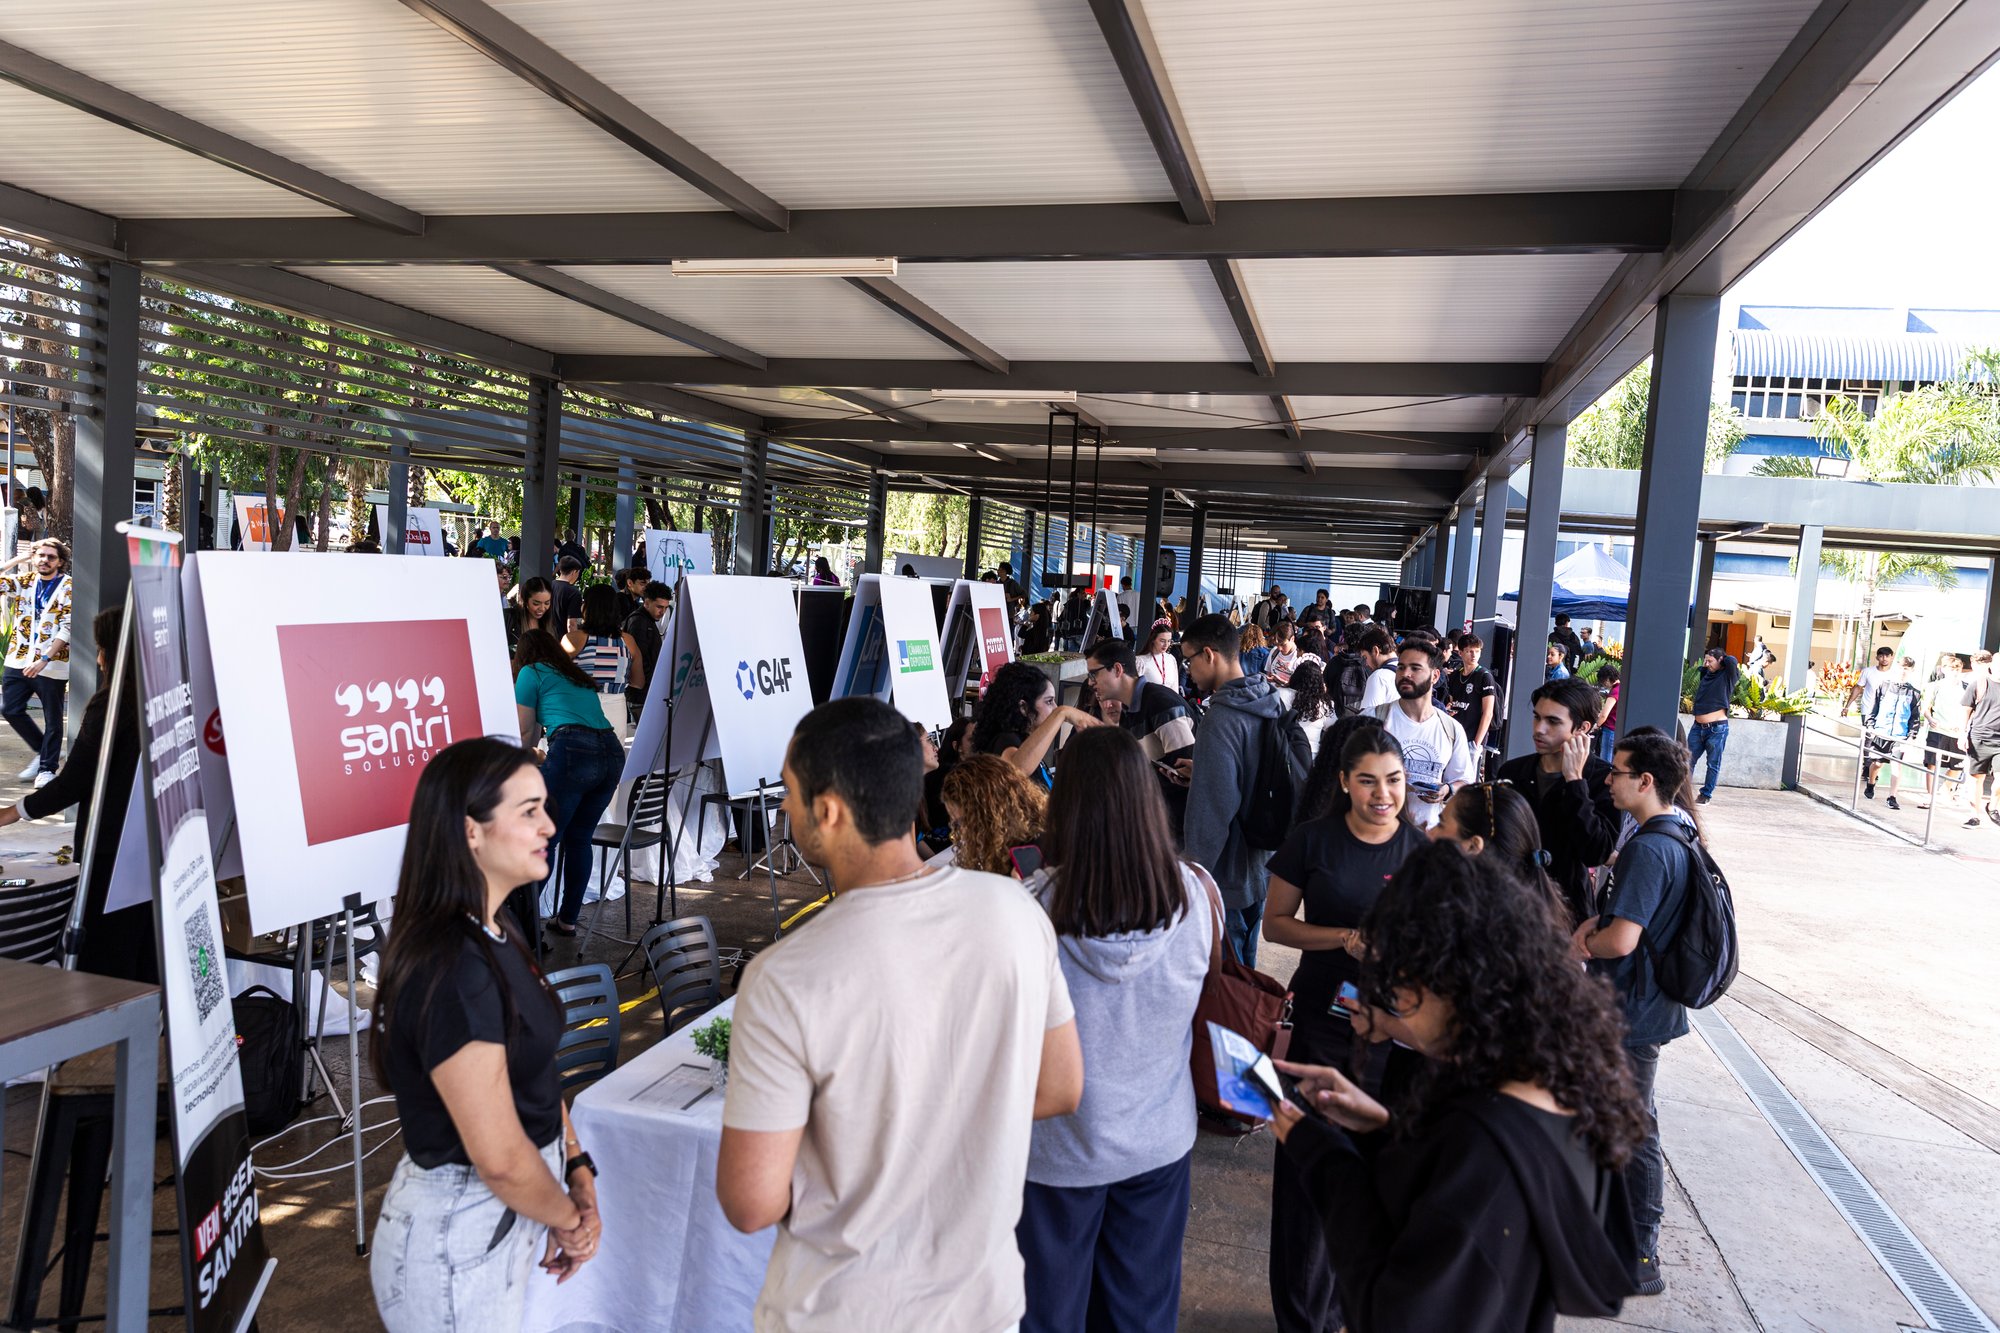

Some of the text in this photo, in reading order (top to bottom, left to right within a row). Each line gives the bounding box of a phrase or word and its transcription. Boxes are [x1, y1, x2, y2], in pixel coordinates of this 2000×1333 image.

[756, 657, 793, 696] G4F
[340, 705, 453, 761] santri
[1411, 738, 1440, 760] CALIFORNIA
[344, 748, 442, 775] SOLUÇÕ
[197, 1205, 221, 1255] VEM
[199, 1187, 259, 1310] SANTRI
